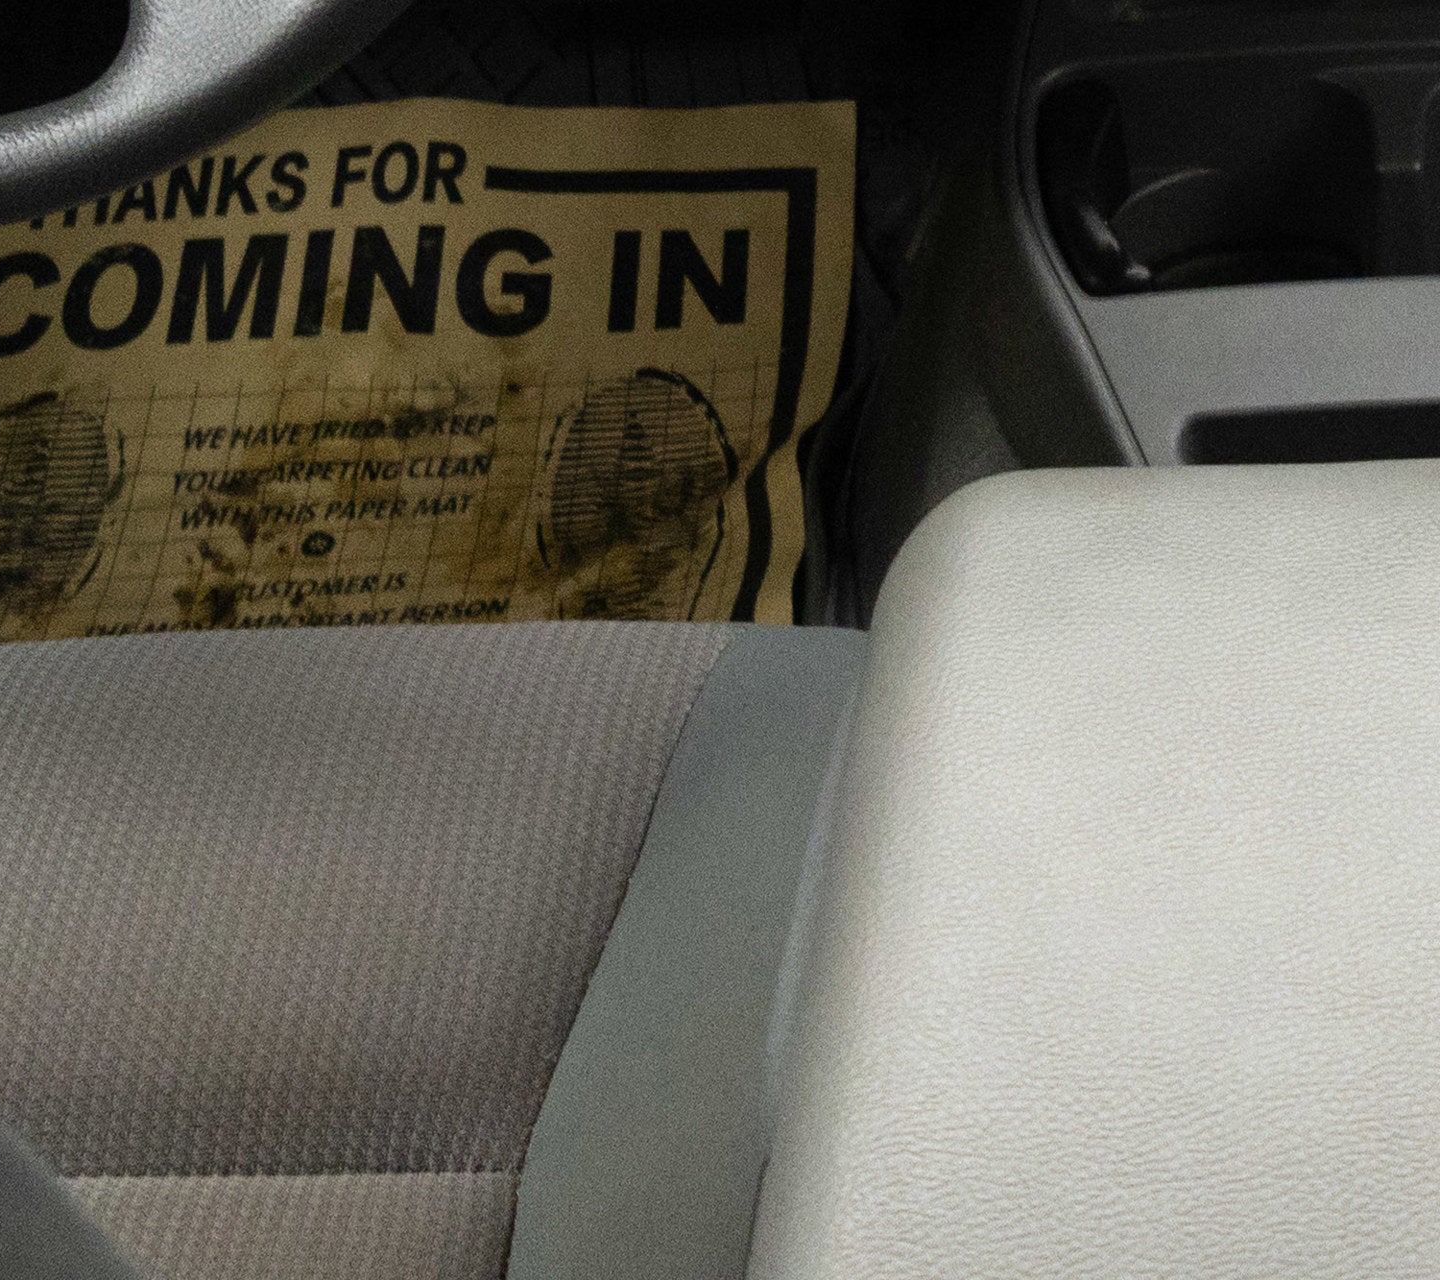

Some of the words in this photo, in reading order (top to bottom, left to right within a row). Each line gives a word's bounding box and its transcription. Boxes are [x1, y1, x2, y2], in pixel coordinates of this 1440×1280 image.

[29, 149, 310, 232] ANKS
[330, 139, 469, 208] FOR
[606, 228, 752, 333] IN
[184, 425, 226, 451] WE
[229, 422, 303, 450] HAVE
[407, 452, 494, 480] CLEAN
[262, 502, 317, 526] THIS
[324, 498, 407, 521] PAPER
[413, 494, 472, 517] MAT
[384, 572, 407, 592] IS
[398, 597, 510, 623] PERSON
